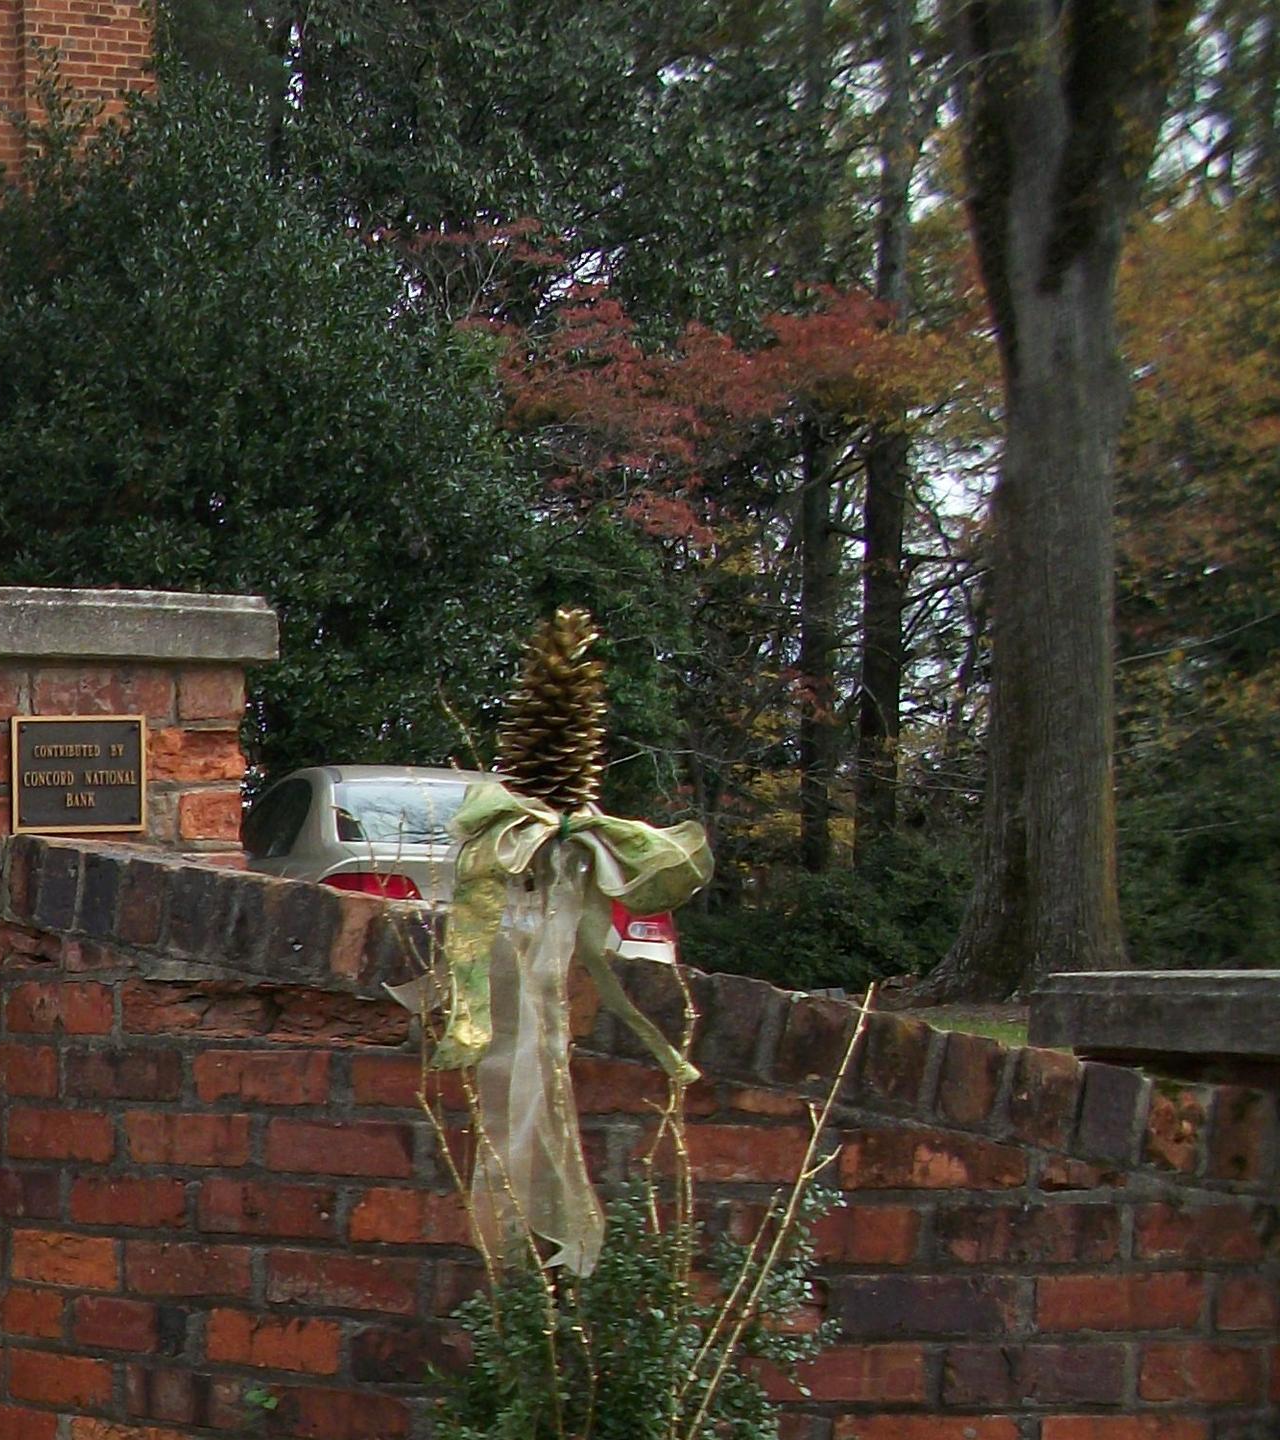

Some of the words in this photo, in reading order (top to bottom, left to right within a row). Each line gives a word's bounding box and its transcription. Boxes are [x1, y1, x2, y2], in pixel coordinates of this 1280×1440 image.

[34, 743, 101, 758] CONTRIBUTED
[111, 743, 124, 757] BY
[23, 769, 75, 788] CONCORD
[85, 769, 137, 787] NATIONAL
[66, 792, 96, 808] BANK
